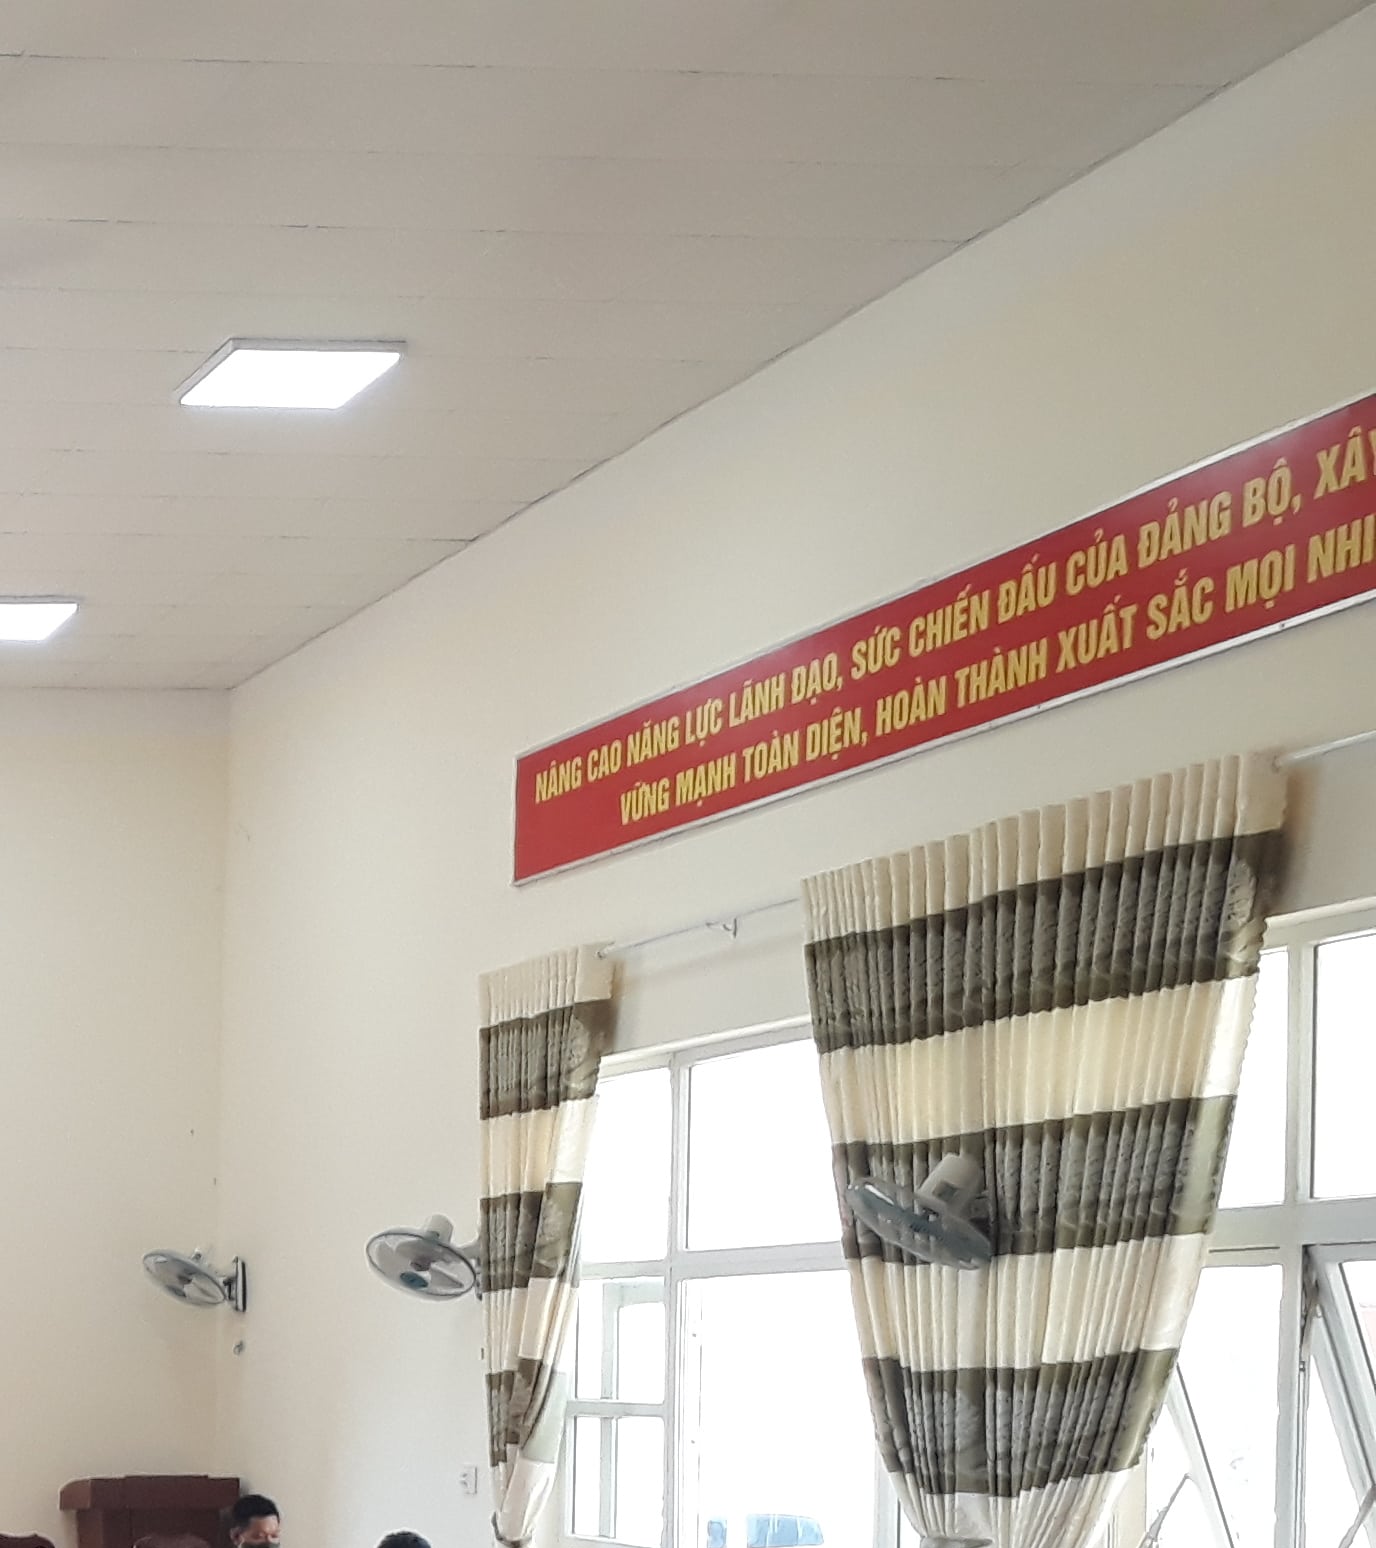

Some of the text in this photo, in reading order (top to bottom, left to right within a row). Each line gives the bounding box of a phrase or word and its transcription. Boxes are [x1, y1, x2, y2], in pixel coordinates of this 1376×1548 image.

[535, 756, 582, 803] NÂNG
[587, 740, 621, 783] CAO
[627, 716, 680, 767] NĂNG
[685, 699, 723, 748] LỰC
[729, 675, 785, 729] LÃNH
[791, 652, 843, 706] ĐẠO,
[851, 625, 901, 680] SỨC
[909, 584, 990, 657] CHIẾN
[998, 553, 1057, 624] ĐẤU
[1065, 528, 1129, 596] CỦA
[1138, 491, 1232, 569] ĐẢNG
[1243, 457, 1301, 527] BỘ,
[620, 782, 670, 825] VỮNG
[675, 755, 736, 807] MẠNH
[743, 730, 799, 783] TOÀN
[806, 707, 869, 762] DIỆN,
[876, 677, 947, 736] HOÀN
[954, 638, 1049, 708] THÀNH
[1056, 595, 1138, 673] XUẤT
[1147, 569, 1215, 640] SẮC
[1226, 544, 1295, 612] MỌI
